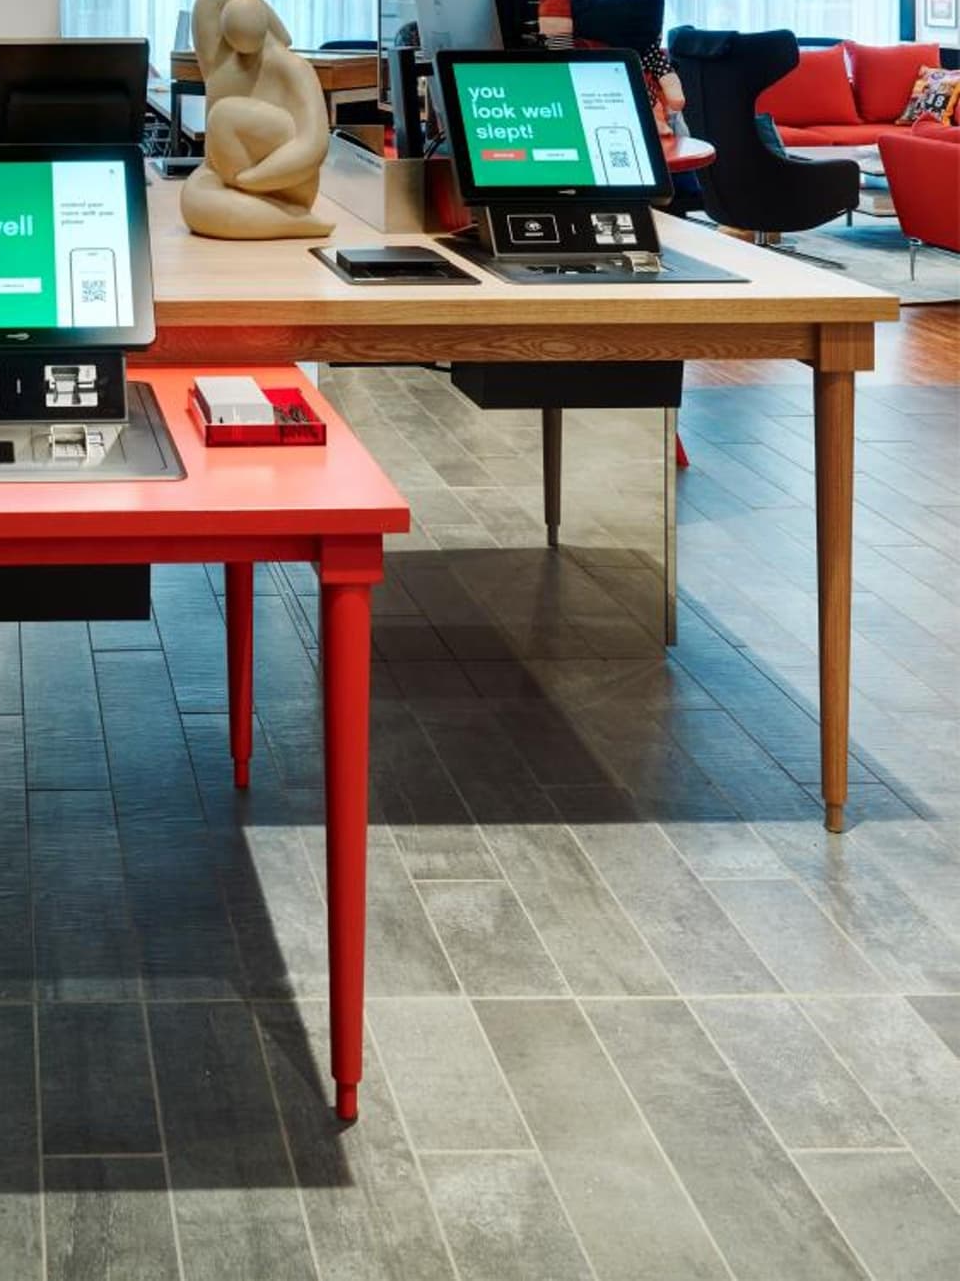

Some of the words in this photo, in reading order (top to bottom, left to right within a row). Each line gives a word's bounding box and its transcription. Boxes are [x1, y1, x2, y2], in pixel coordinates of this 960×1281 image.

[468, 86, 506, 102] you
[472, 101, 516, 119] look
[522, 102, 563, 119] well
[476, 124, 534, 143] slept!
